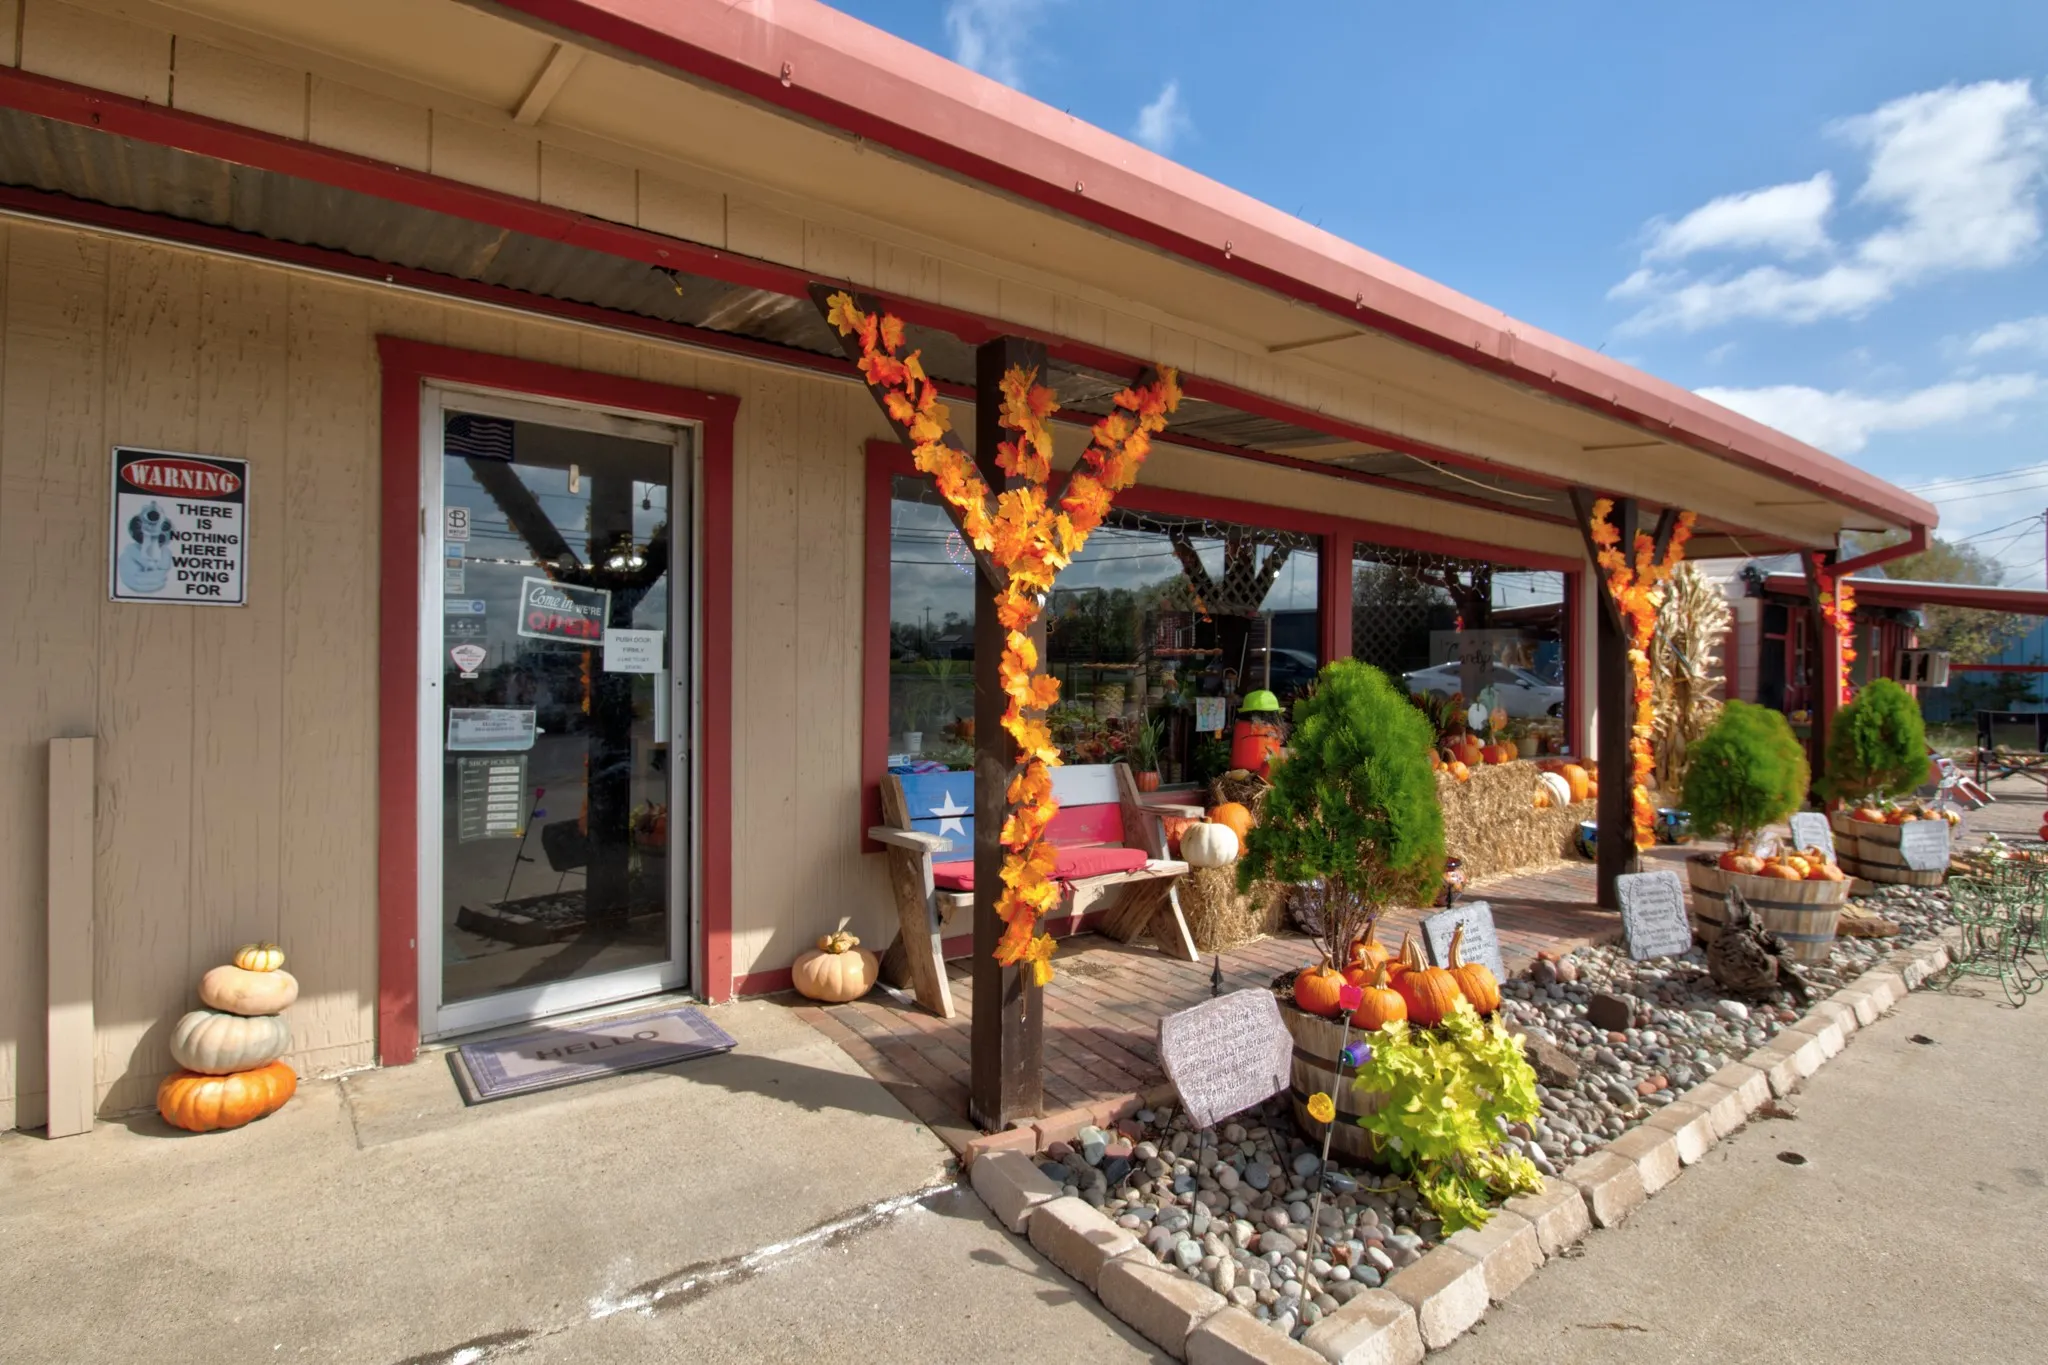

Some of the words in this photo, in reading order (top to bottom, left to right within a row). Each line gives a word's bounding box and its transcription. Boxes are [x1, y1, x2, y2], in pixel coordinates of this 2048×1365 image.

[131, 464, 235, 493] WARNING
[176, 503, 233, 518] THERE
[197, 519, 212, 530] IS
[170, 530, 239, 545] NOTHING
[181, 544, 227, 557] HERE
[172, 556, 235, 571] WORTH
[177, 570, 230, 583] DYING
[186, 583, 221, 596] FOR
[529, 586, 561, 608] Come
[561, 596, 574, 609] in
[527, 611, 600, 638] OPEN
[535, 1030, 659, 1061] HELLO
